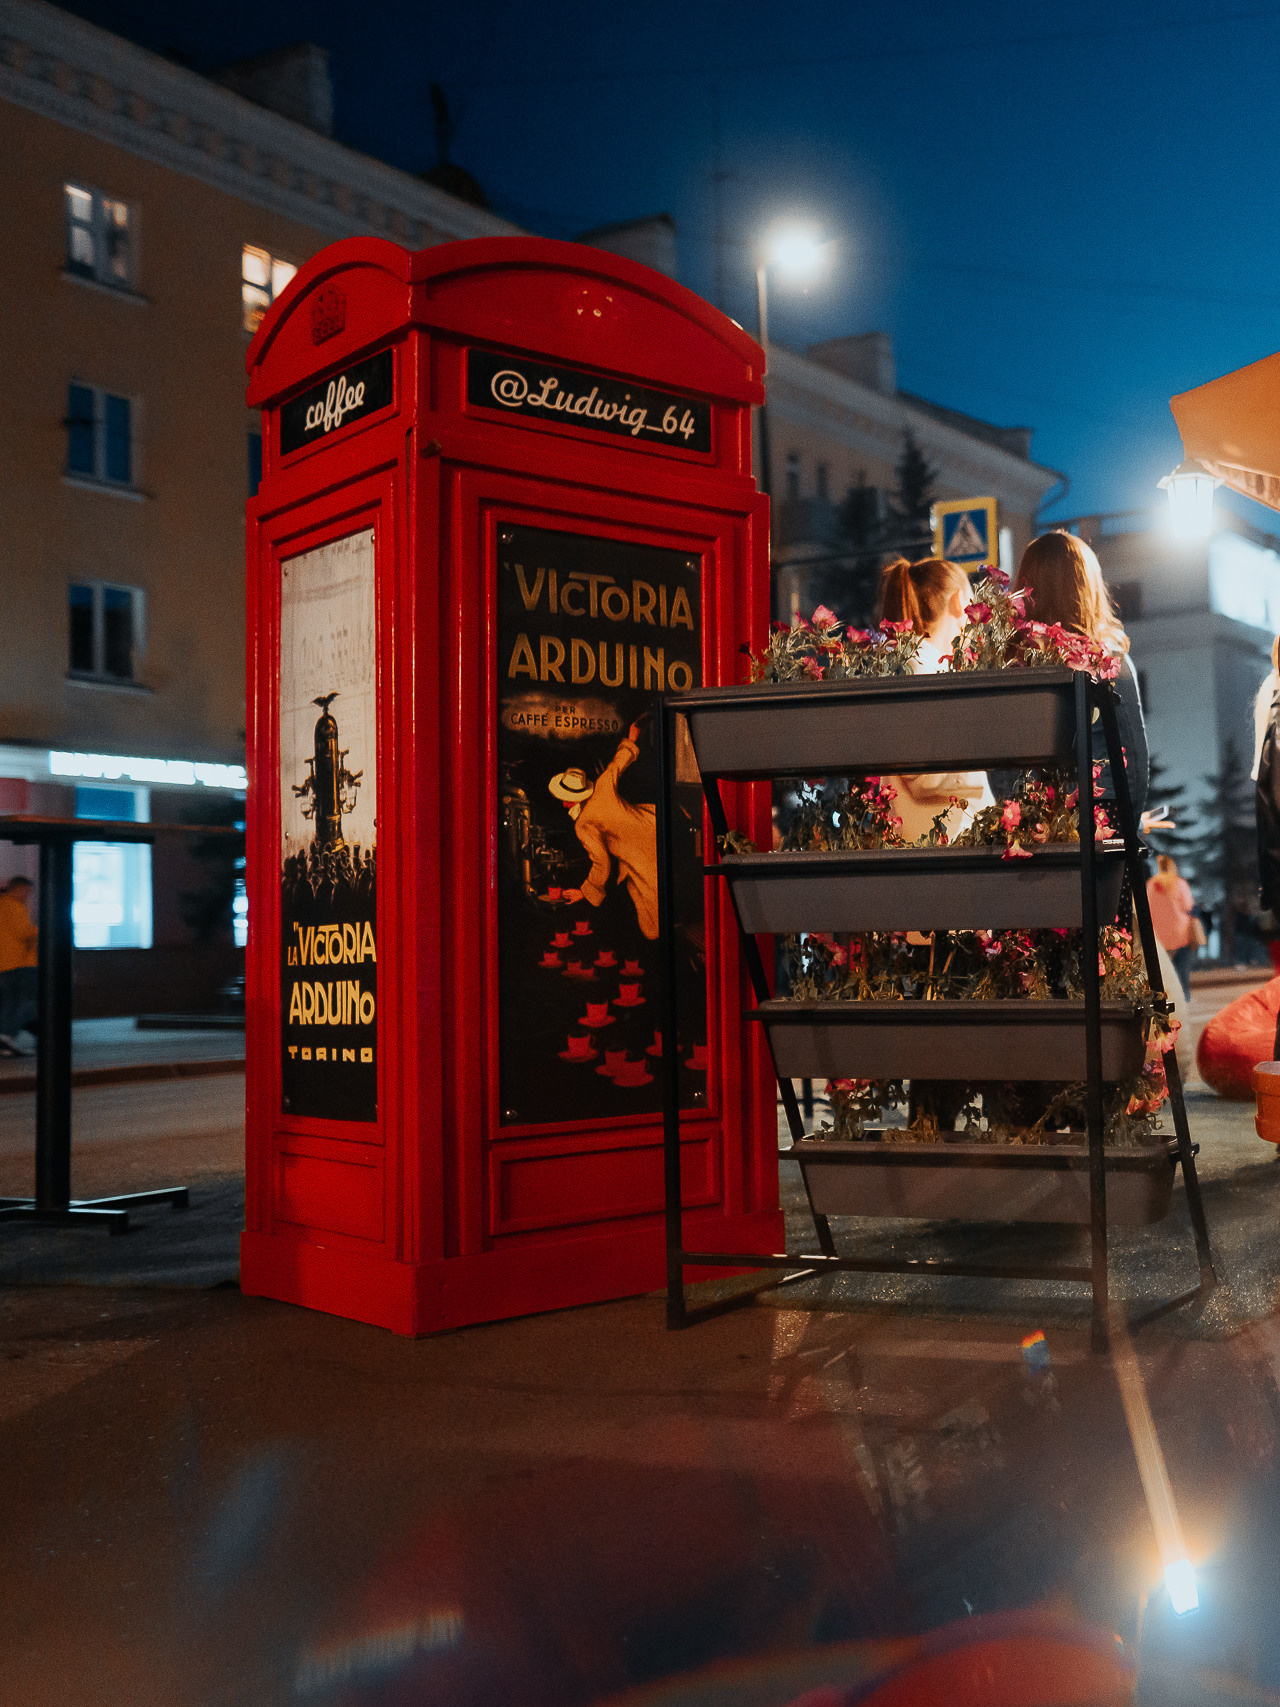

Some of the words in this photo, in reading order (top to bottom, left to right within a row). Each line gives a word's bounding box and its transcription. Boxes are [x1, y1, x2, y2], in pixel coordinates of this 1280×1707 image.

[303, 375, 365, 432] coffee
[491, 369, 696, 440] @Ludwig_64
[507, 632, 694, 693] ARDUINO
[555, 705, 576, 714] PER
[555, 715, 619, 732] ESPRESSO
[287, 946, 299, 966] LA
[289, 980, 376, 1026] ARDUINO
[288, 1045, 374, 1064] TORINO
